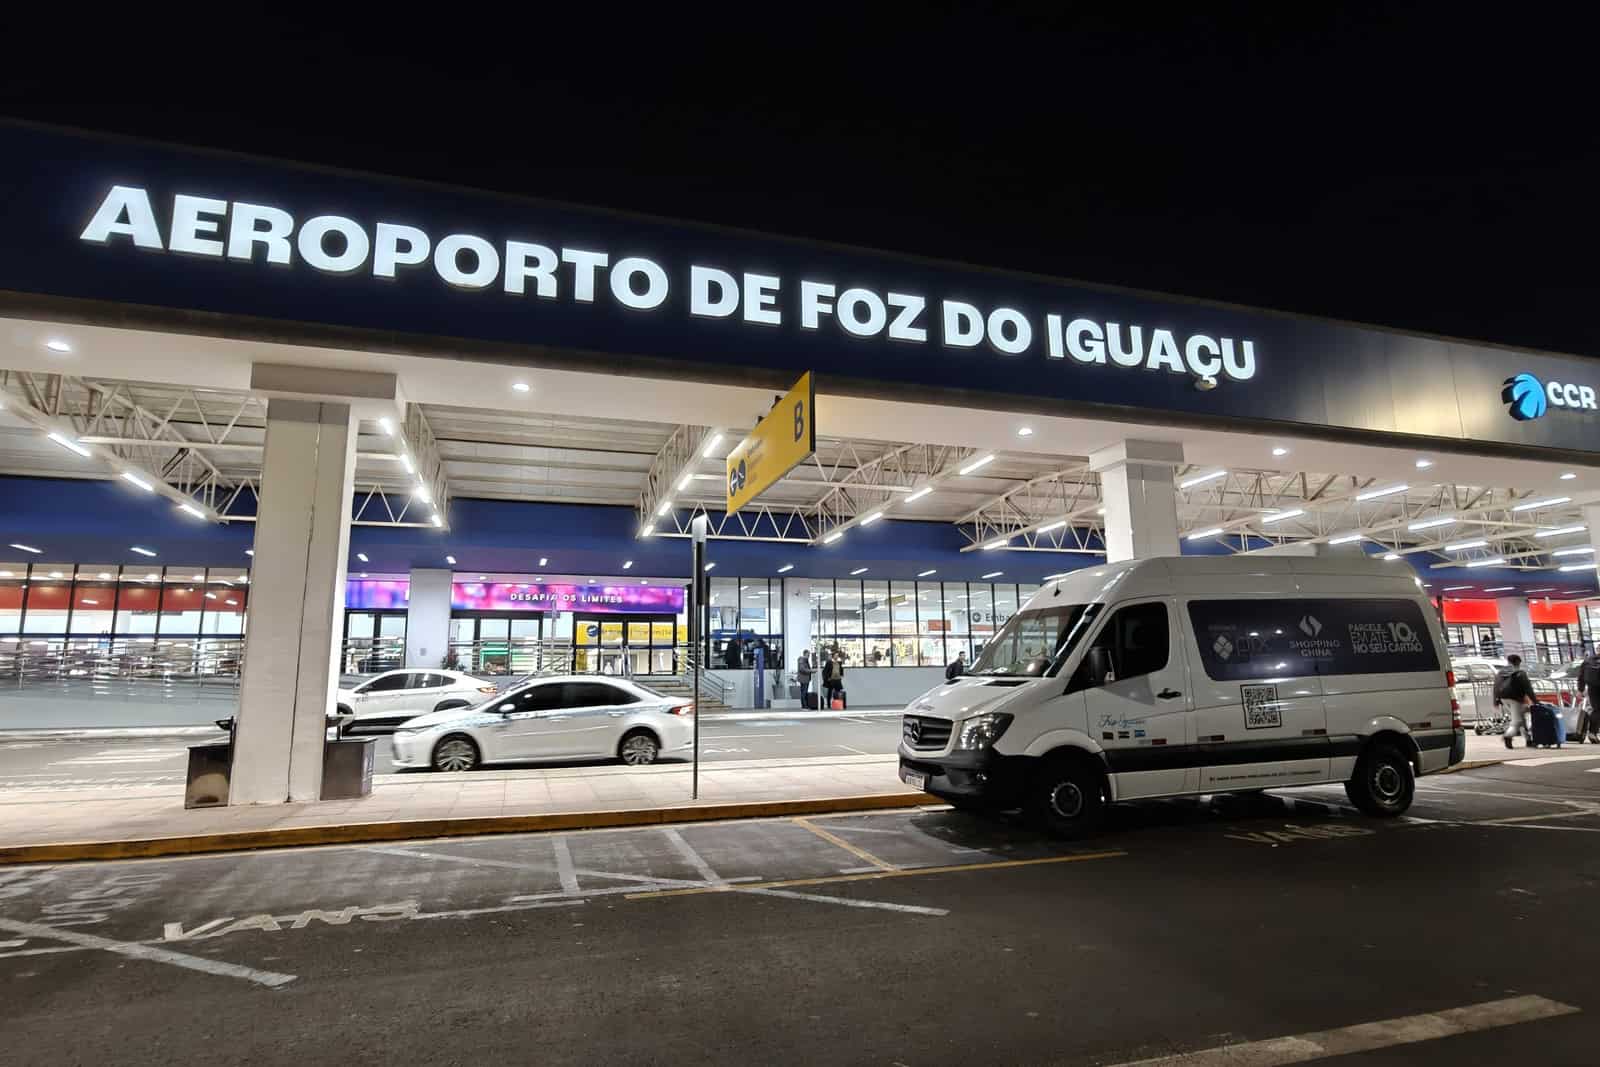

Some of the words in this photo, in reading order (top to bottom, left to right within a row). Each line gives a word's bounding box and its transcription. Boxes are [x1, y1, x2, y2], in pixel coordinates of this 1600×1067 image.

[80, 185, 669, 310] AEROPORTO
[690, 265, 781, 325] DE
[801, 280, 928, 342] FOZ
[943, 300, 1032, 354] DO
[1047, 314, 1256, 382] IGUAÇU
[1547, 381, 1597, 410] CCR
[794, 399, 804, 442] B
[562, 594, 577, 602] OS
[582, 595, 623, 603] LIMITES
[1289, 640, 1341, 648] SHOPPING
[1300, 649, 1332, 657] CHINA
